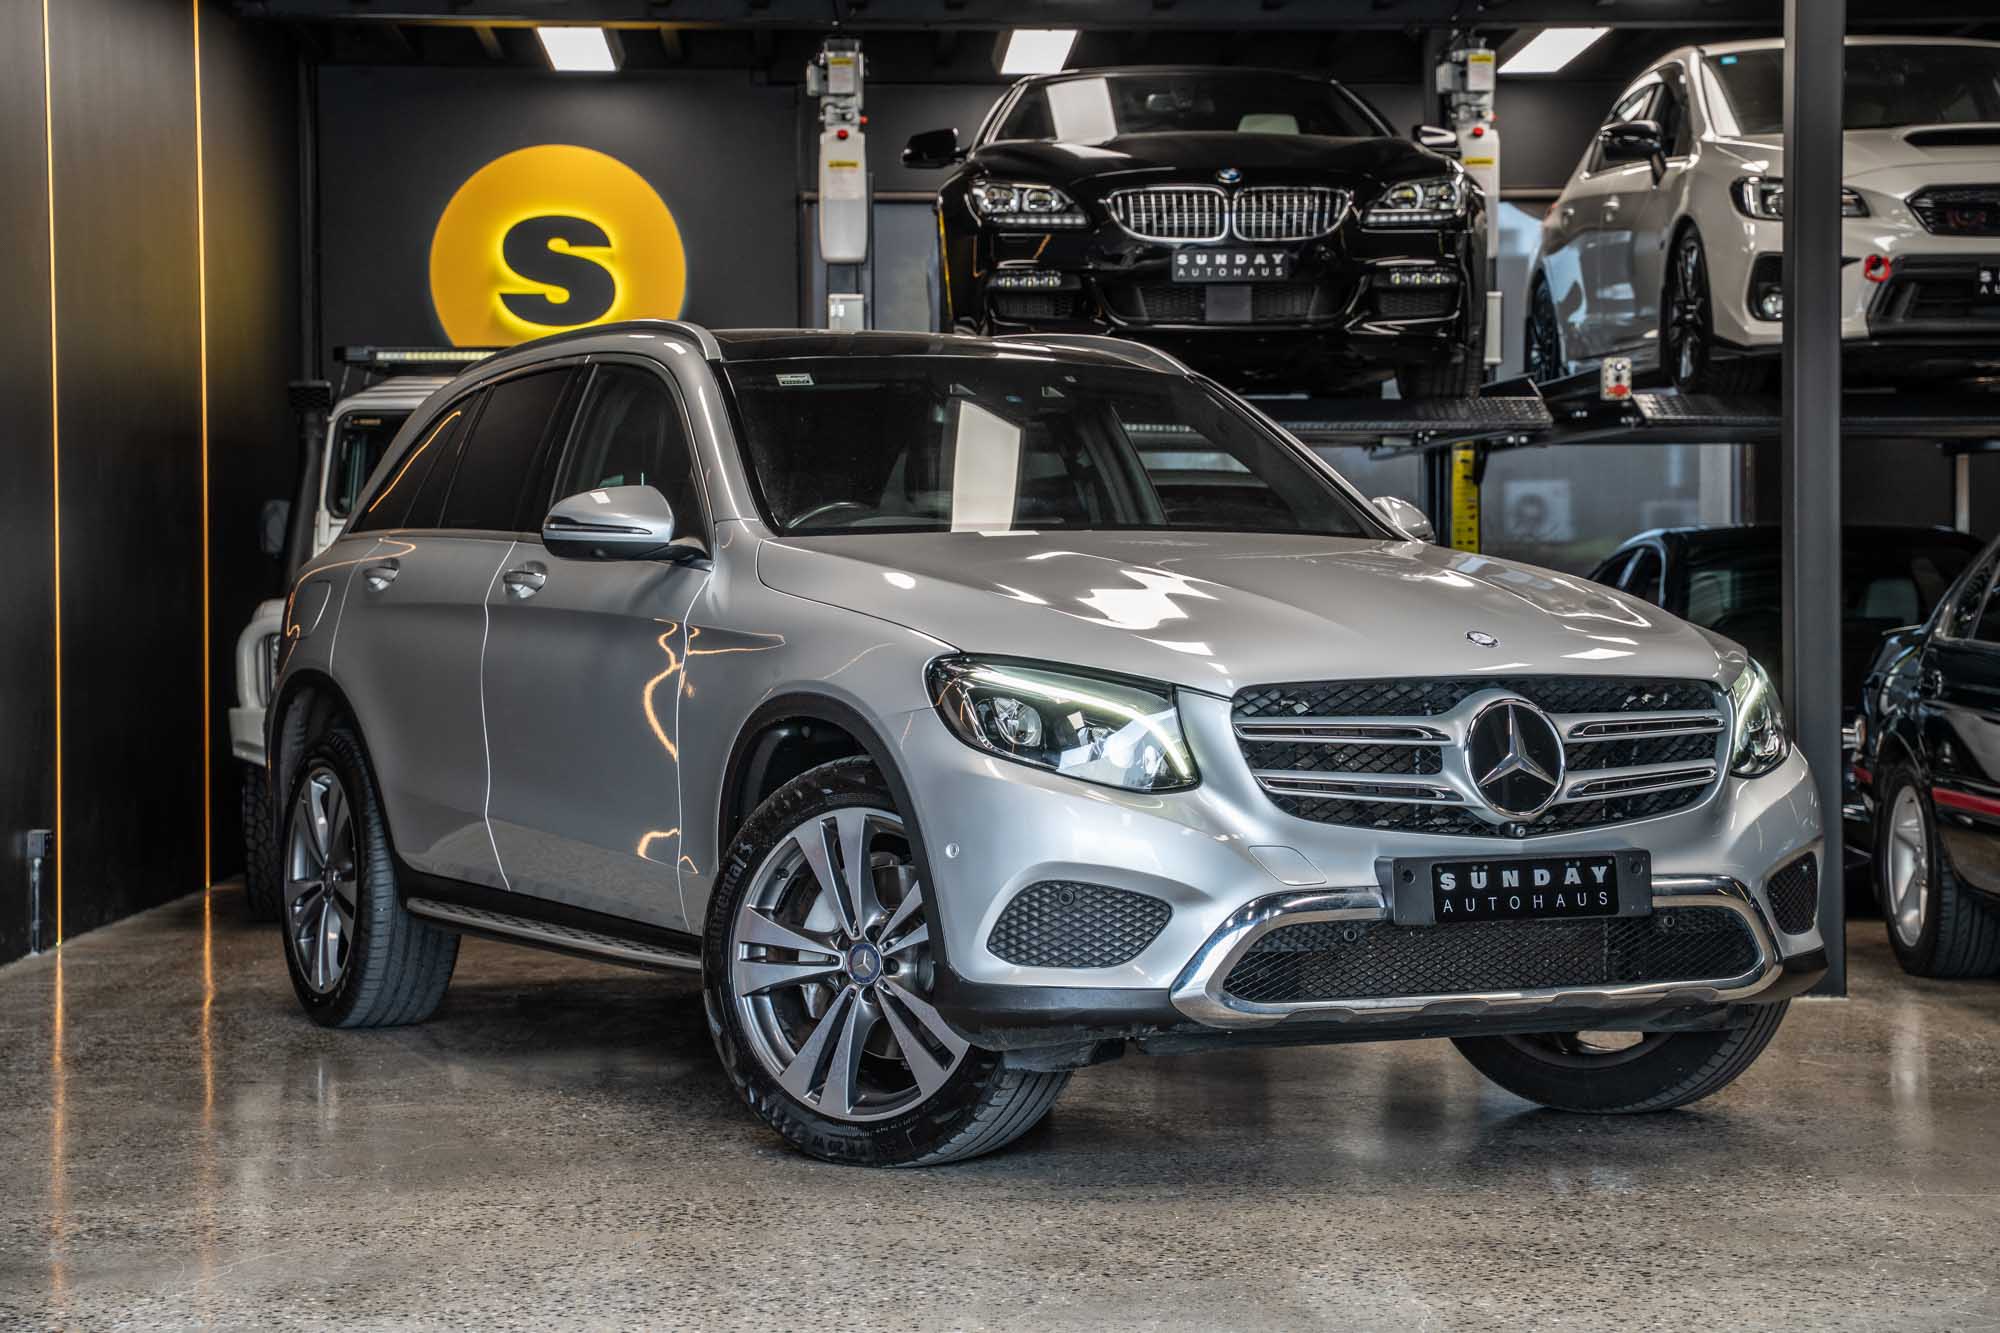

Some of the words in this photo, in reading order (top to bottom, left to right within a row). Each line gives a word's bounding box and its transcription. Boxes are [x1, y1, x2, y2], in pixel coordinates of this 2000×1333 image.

[1177, 253, 1284, 265] SUNDAY
[499, 215, 616, 326] S
[1177, 267, 1283, 277] AUTOHAUS
[1979, 270, 2000, 283] S
[1443, 892, 1608, 912] AUTOHAUS
